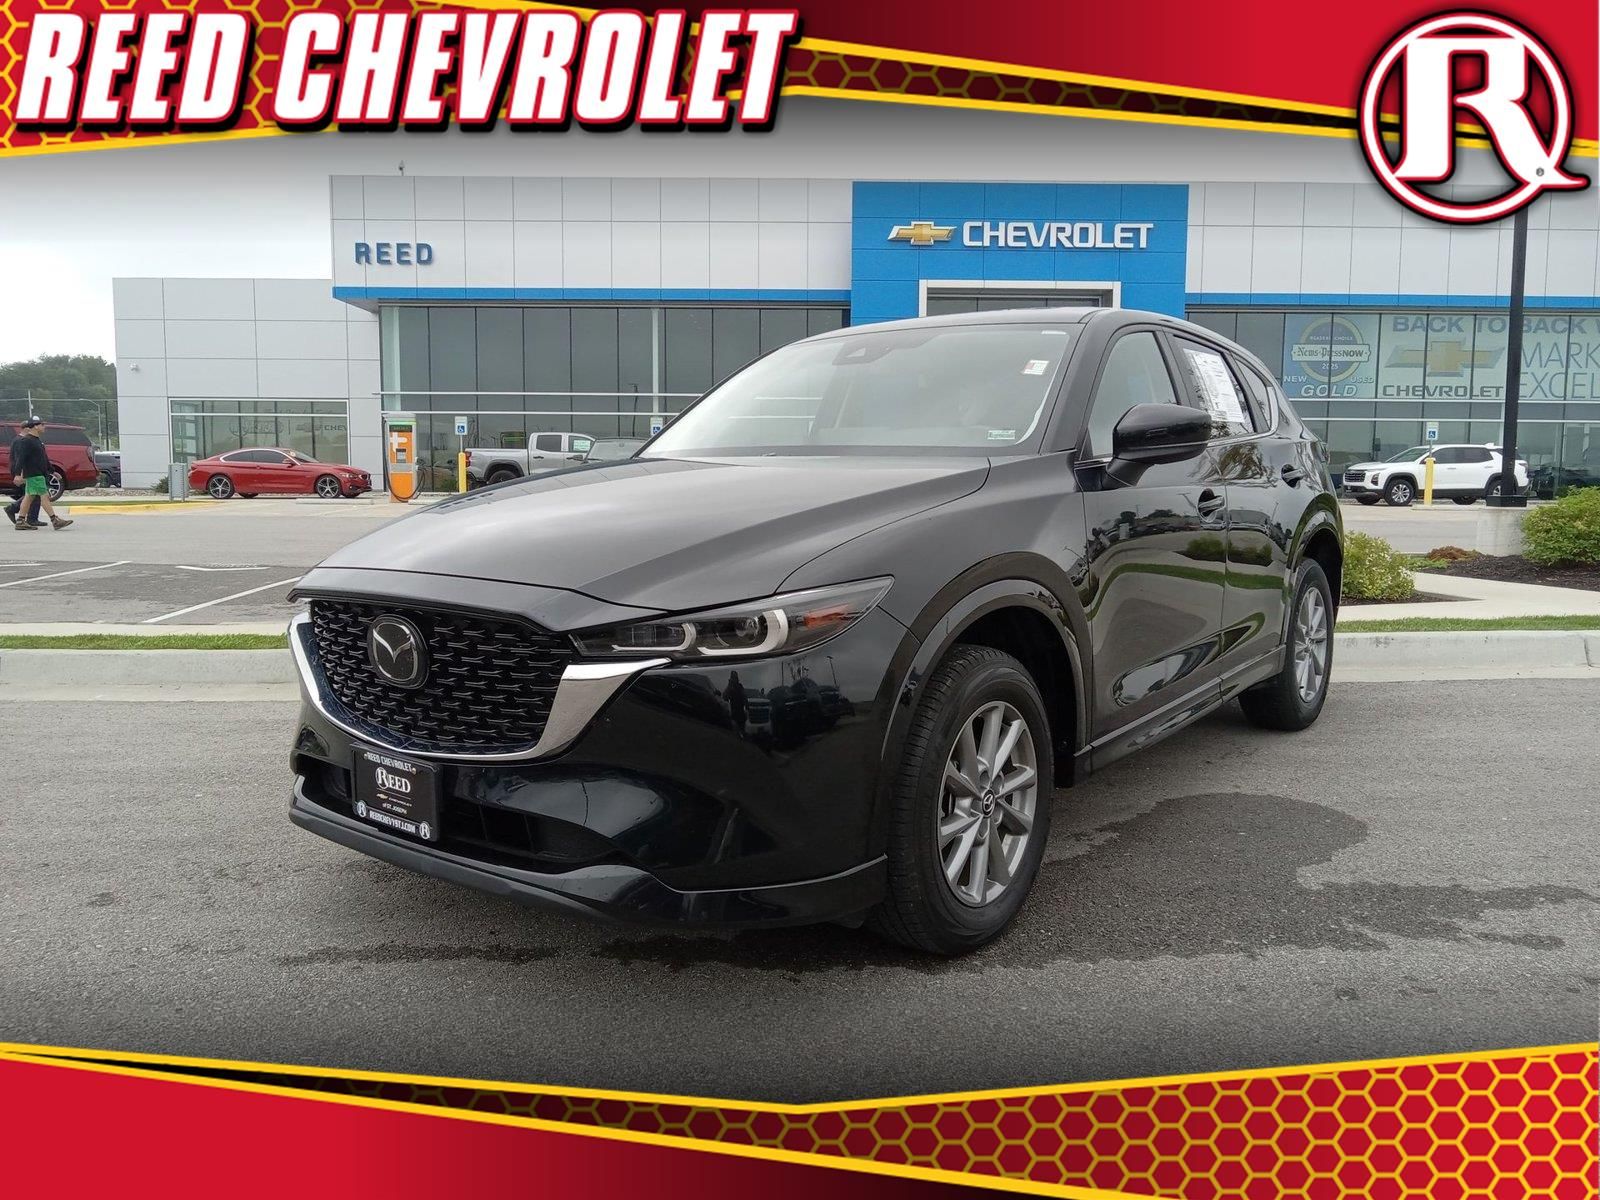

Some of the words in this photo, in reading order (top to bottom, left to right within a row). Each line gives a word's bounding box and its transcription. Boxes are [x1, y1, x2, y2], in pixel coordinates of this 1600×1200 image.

[961, 220, 1154, 250] CHEVROLET
[354, 241, 434, 265] REED
[1392, 315, 1465, 332] BACK
[1476, 316, 1508, 333] TO
[1284, 375, 1308, 383] NEW
[1350, 375, 1375, 384] USED
[1300, 384, 1358, 397] GOLD
[1382, 384, 1504, 398] CHEVROLET
[366, 752, 381, 764] REED
[381, 756, 412, 772] CHEVROLET
[375, 766, 411, 793] REED
